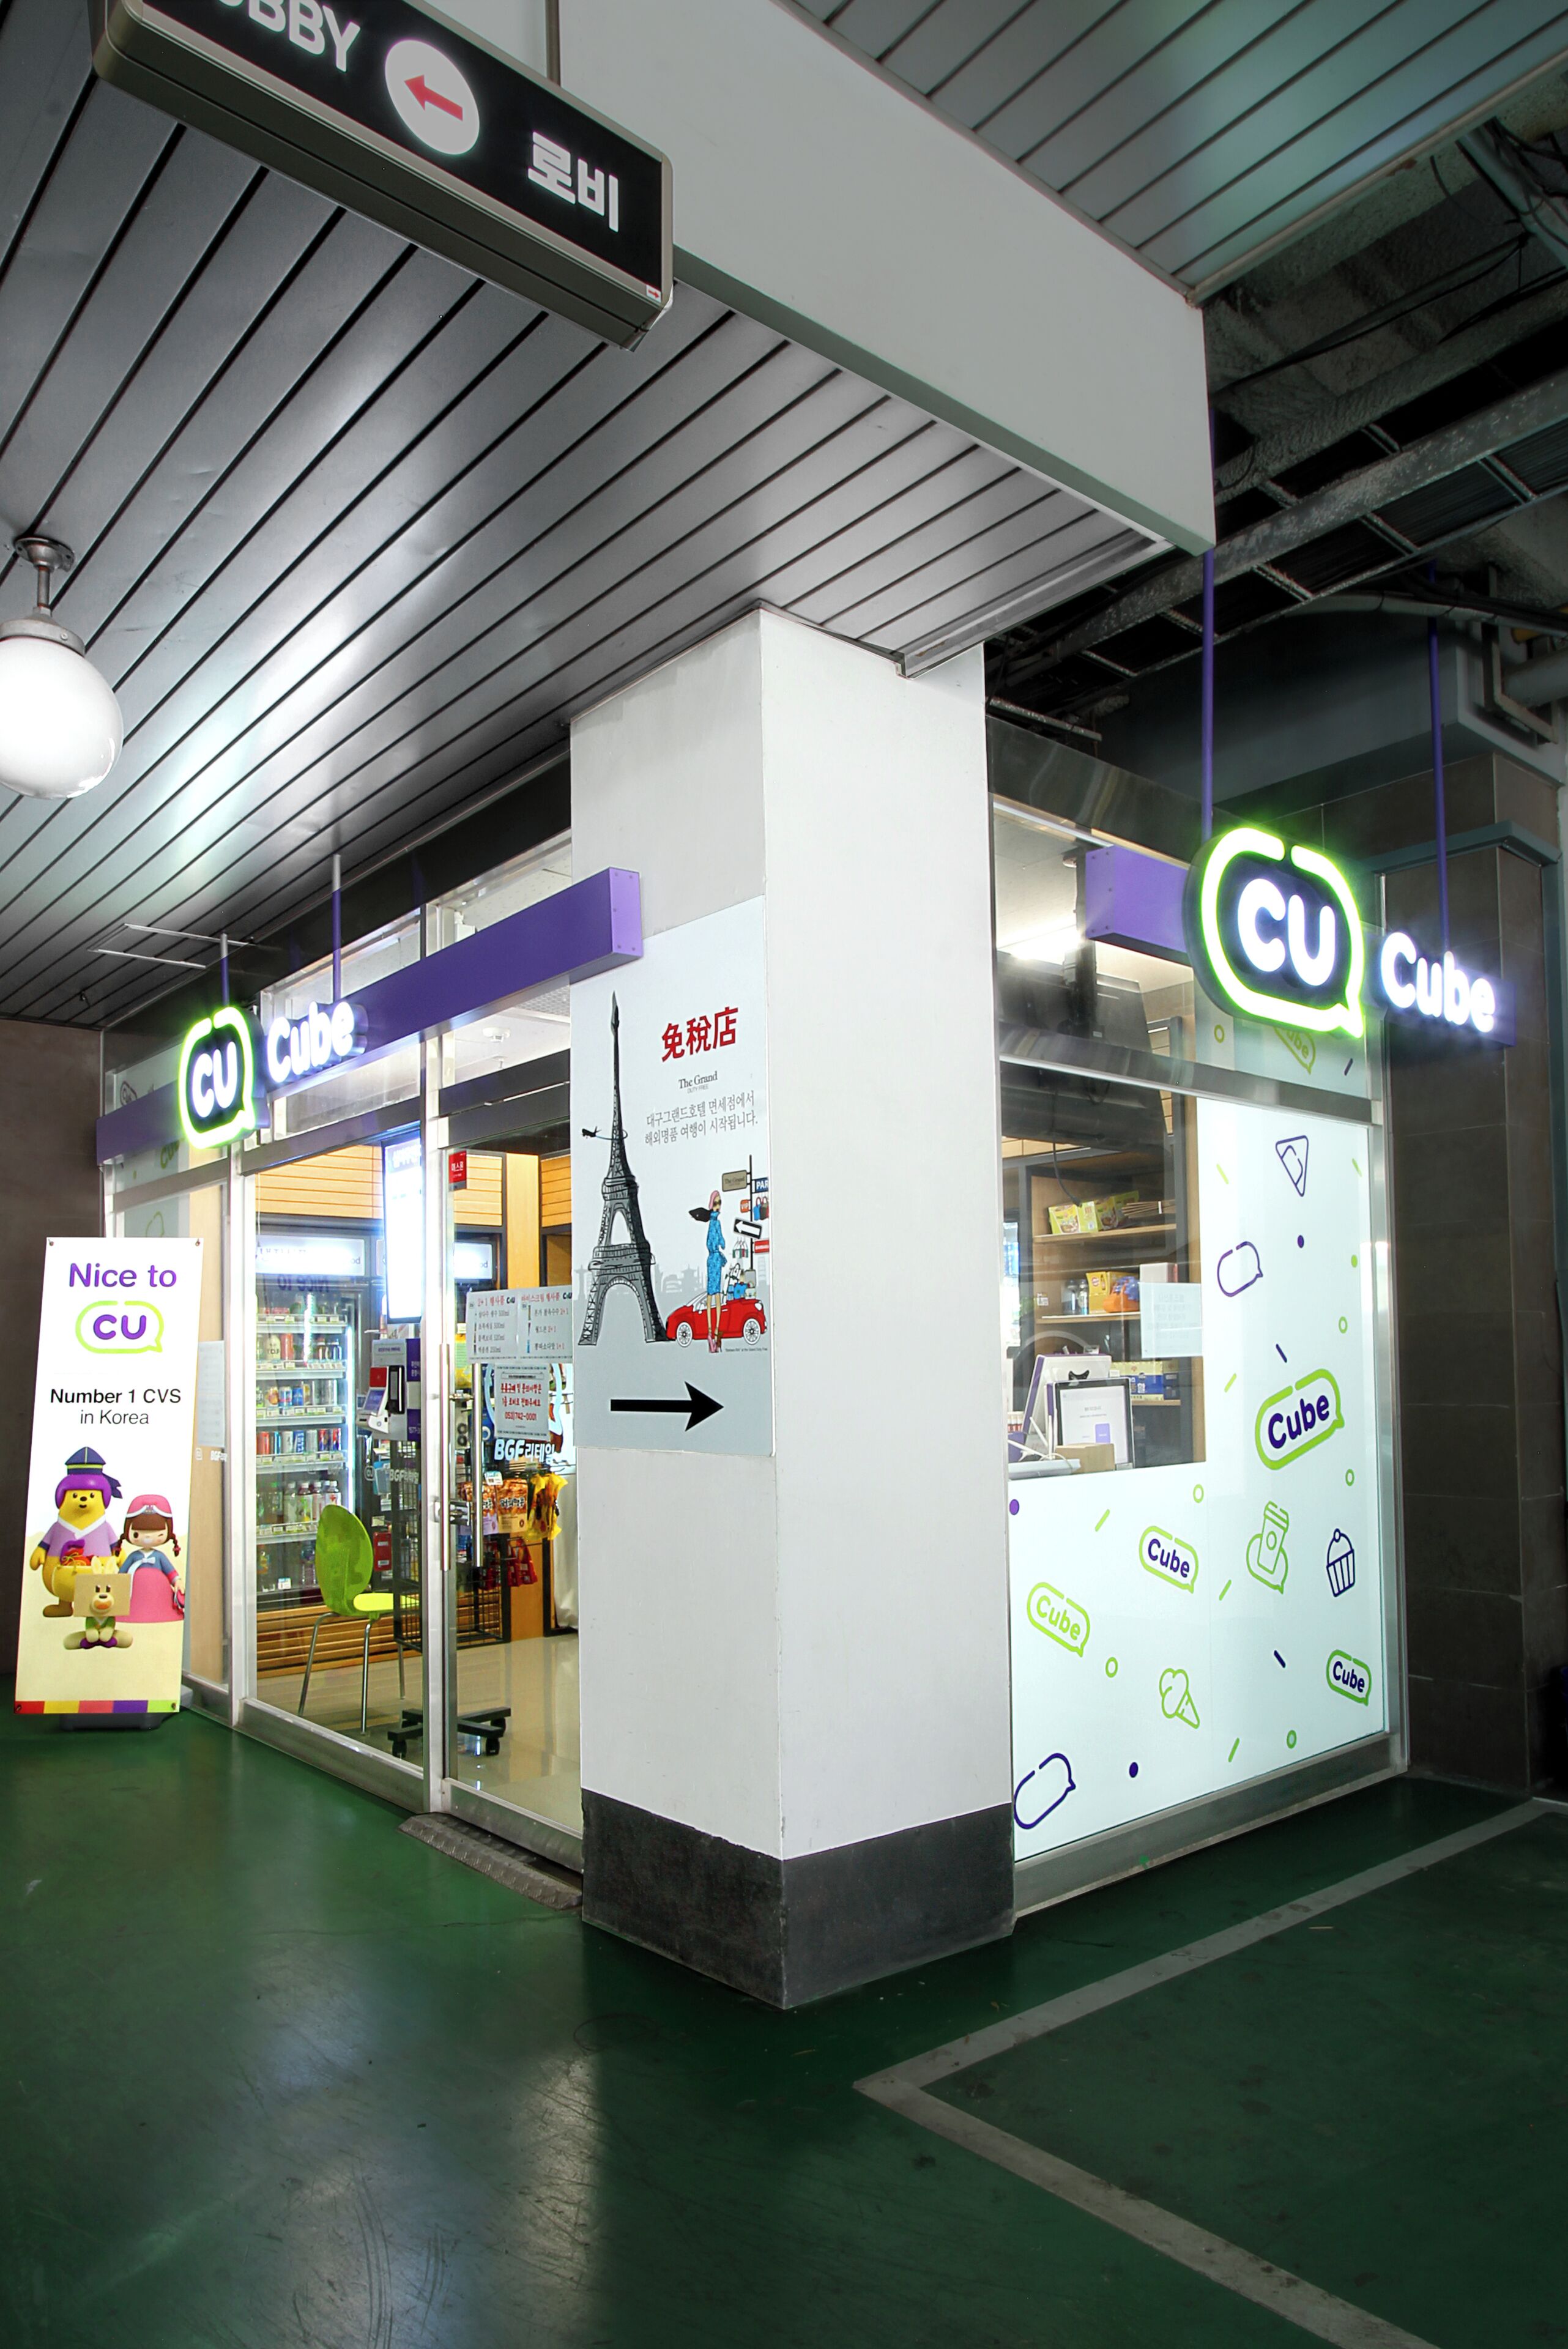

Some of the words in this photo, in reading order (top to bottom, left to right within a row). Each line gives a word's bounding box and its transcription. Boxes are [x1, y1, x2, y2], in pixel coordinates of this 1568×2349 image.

[218, 0, 361, 72] BY
[527, 131, 619, 232] 로비
[1237, 878, 1336, 987] CU
[1380, 932, 1496, 1033] Cube
[267, 1001, 355, 1083] Cube
[1286, 1030, 1309, 1059] ube
[192, 1041, 237, 1118] CU
[678, 1078, 693, 1089] The
[694, 1071, 718, 1086] Grand
[647, 1101, 706, 1127] 대구그랜드호텔
[708, 1090, 754, 1115] 면세점에서
[645, 1126, 678, 1146] 해외명품
[680, 1120, 706, 1140] 여행이
[710, 1110, 758, 1134] 시작됩니다.
[69, 1263, 137, 1287] Nice
[147, 1265, 177, 1287] to
[93, 1314, 147, 1340] CU
[50, 1389, 122, 1404] Number
[128, 1390, 135, 1403] 1
[143, 1389, 181, 1403] CVS
[80, 1409, 94, 1424] in
[100, 1409, 149, 1425] Korea
[1268, 1395, 1330, 1449] Cube
[494, 1439, 555, 1464] BGF리테일
[1147, 1538, 1190, 1578] Cube
[1036, 1595, 1081, 1641] Cube
[1332, 1661, 1365, 1693] Cube
